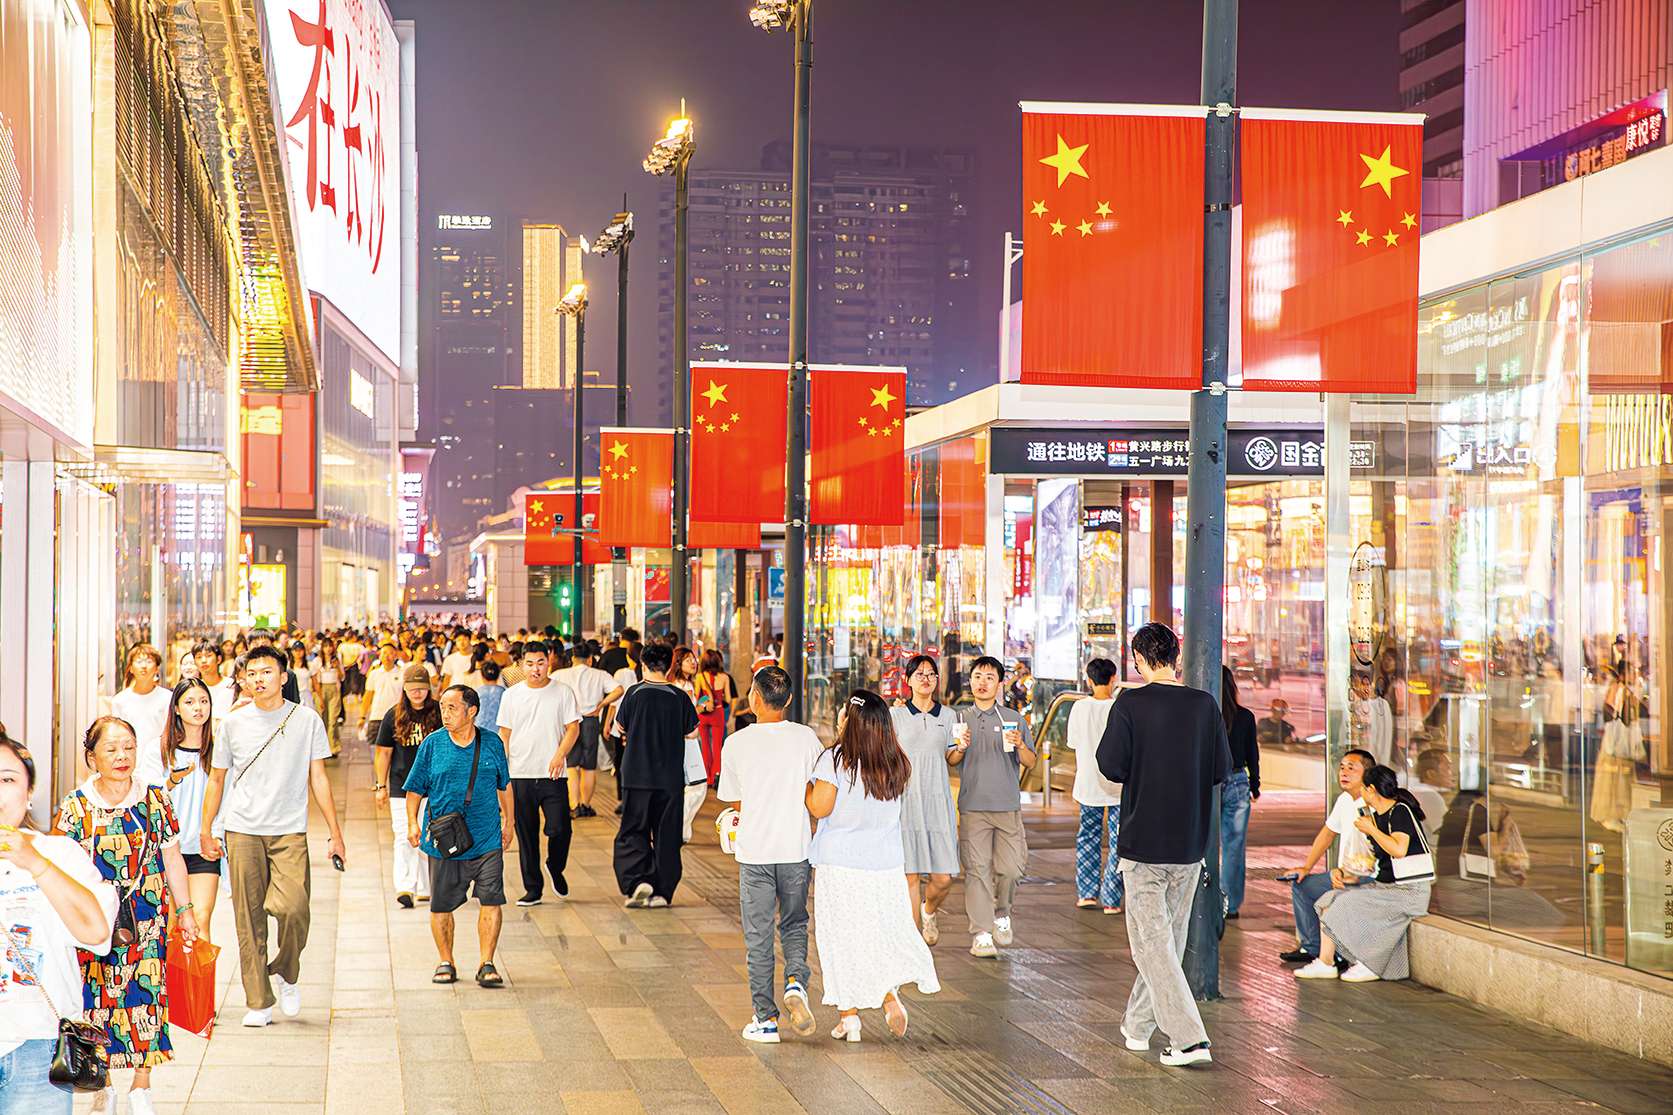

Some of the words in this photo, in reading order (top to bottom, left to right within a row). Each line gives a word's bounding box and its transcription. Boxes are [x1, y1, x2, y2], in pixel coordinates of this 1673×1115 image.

[1027, 441, 1106, 461] 通往地铁
[1476, 445, 1530, 464] 出入口
